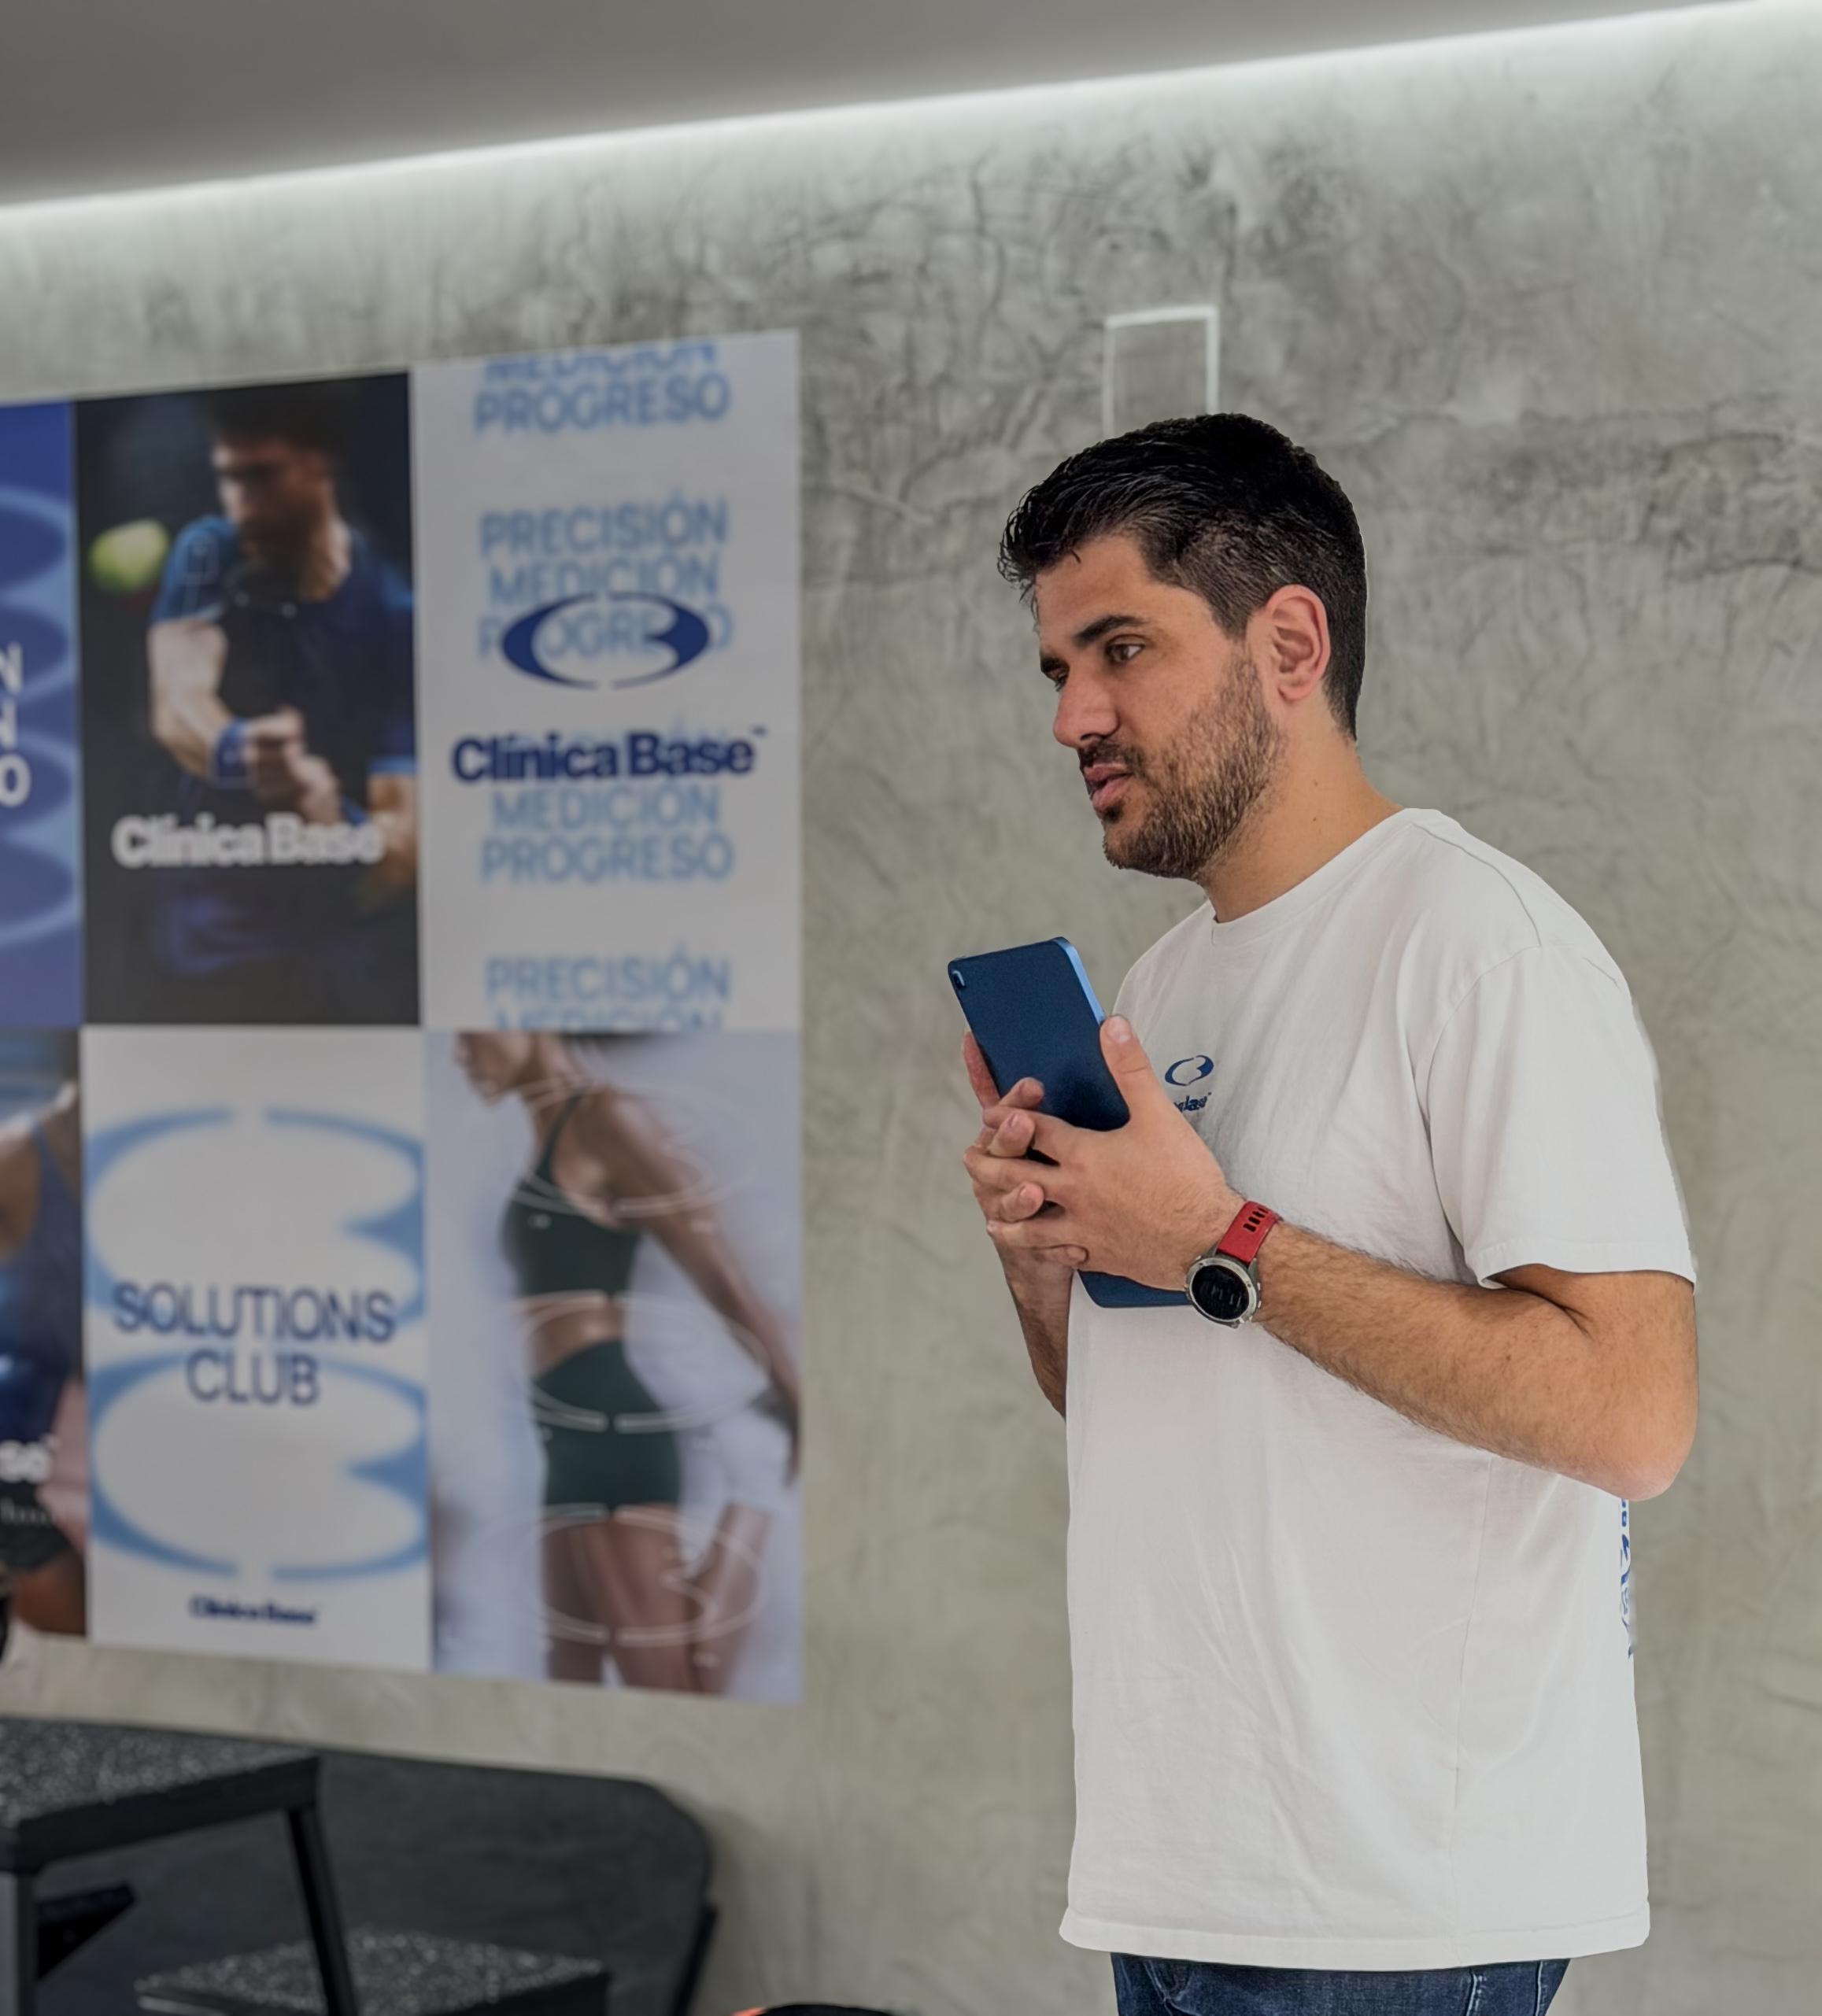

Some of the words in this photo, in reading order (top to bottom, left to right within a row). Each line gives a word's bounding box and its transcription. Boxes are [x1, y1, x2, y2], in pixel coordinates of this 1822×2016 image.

[475, 373, 731, 435] PROGRESO
[479, 491, 728, 556] PRECISIÓN
[482, 835, 734, 884] PROGRESO
[485, 943, 731, 1002] PRECISIÓN
[113, 1282, 396, 1343] SOLUTIONS
[185, 1350, 319, 1405] CLUB
